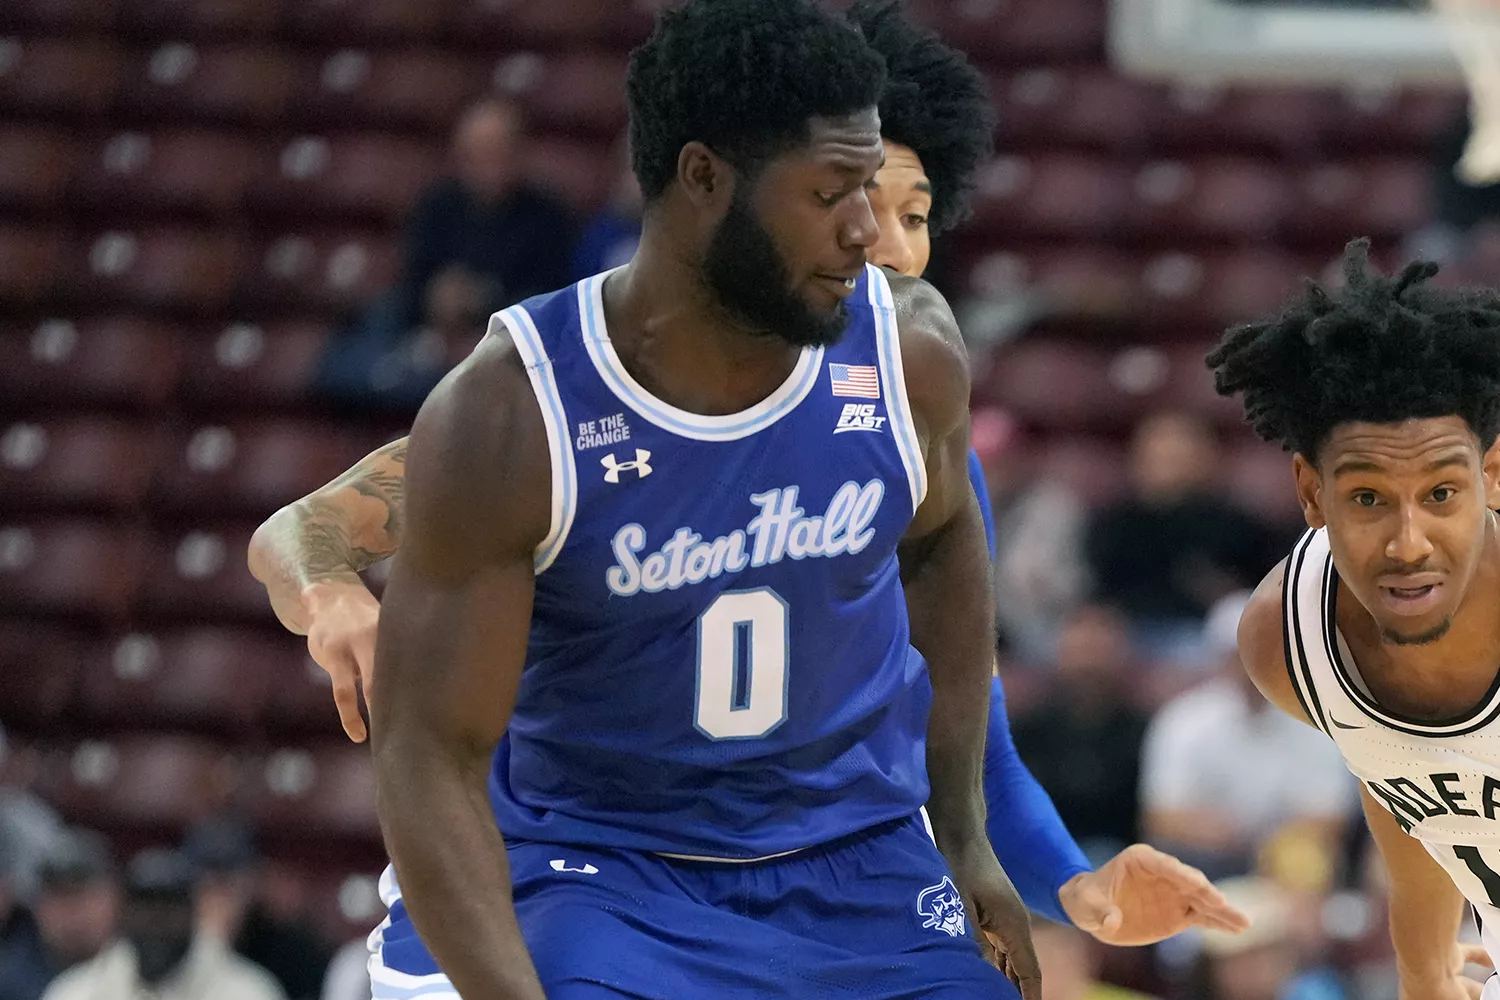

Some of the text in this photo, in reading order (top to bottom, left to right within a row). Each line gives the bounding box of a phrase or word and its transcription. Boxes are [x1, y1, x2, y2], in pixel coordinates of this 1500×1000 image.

[836, 415, 887, 429] EAST
[841, 403, 876, 417] BIG
[578, 412, 625, 436] BE THE
[576, 425, 631, 451] CHANGE
[606, 478, 885, 597] Seton Hall
[693, 585, 790, 742] 0
